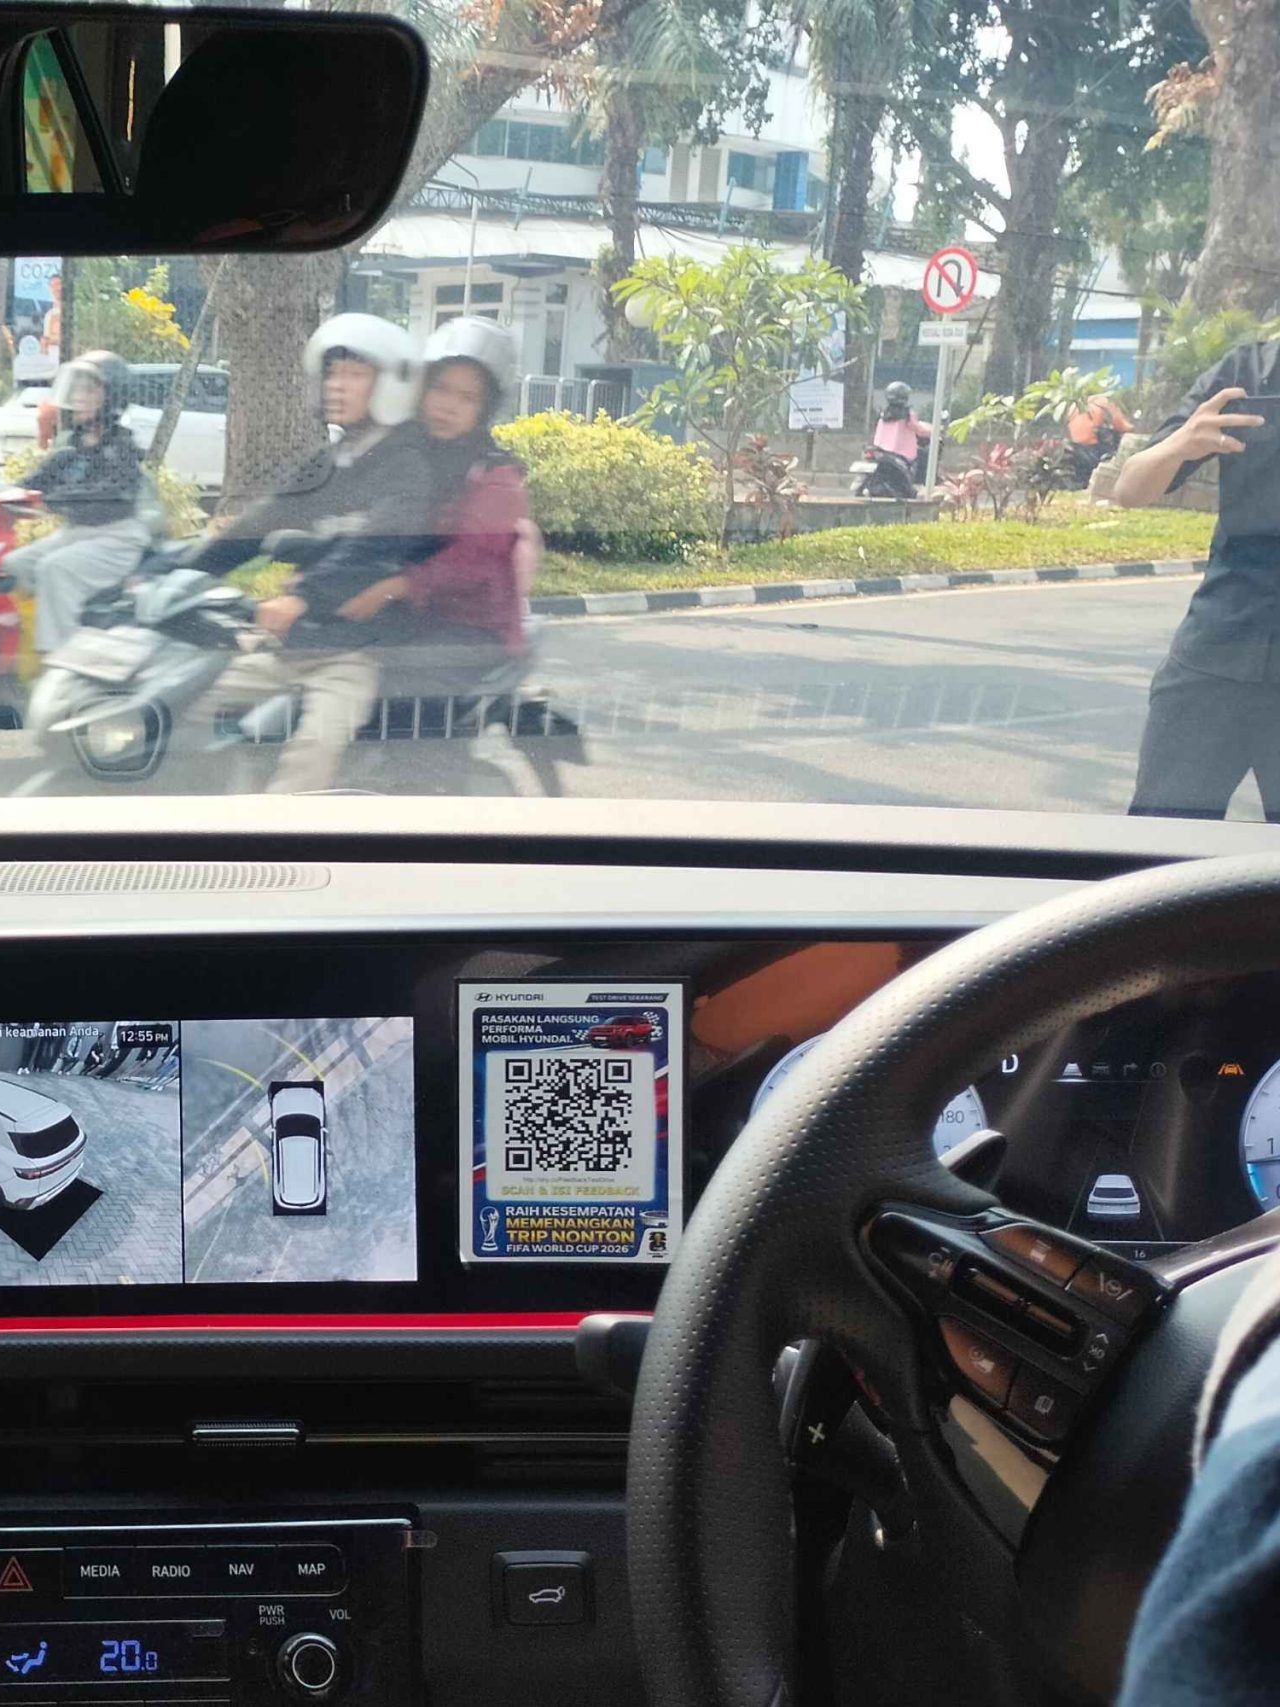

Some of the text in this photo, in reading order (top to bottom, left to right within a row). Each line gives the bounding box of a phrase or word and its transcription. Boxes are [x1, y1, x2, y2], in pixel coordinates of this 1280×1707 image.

[495, 993, 544, 1002] HYUNDAI
[481, 1014, 600, 1024] RASAKAN LANGSUNG
[5, 1026, 66, 1038] keamanan
[481, 1025, 543, 1034] PERFORMA
[120, 1030, 169, 1042] 12:55 PM
[481, 1035, 518, 1044] MOBIL
[941, 1110, 965, 1124] 180
[1267, 1137, 1274, 1155] 1
[505, 1206, 635, 1217] RAIH KESEMPATAN
[505, 1218, 635, 1229] MEMENANGKAN
[506, 1230, 635, 1243] TRIP NONTON
[506, 1244, 530, 1253] FIFA
[531, 1244, 575, 1253] WORLD
[576, 1244, 599, 1253] CUP
[80, 1565, 121, 1578] MEDIA
[151, 1565, 191, 1578] RADIO
[228, 1563, 255, 1576] NAV
[297, 1563, 326, 1576] MAP
[258, 1605, 285, 1616] PWR
[329, 1608, 352, 1621] VOL
[259, 1616, 285, 1626] PUSH
[99, 1639, 159, 1672] 20.0
